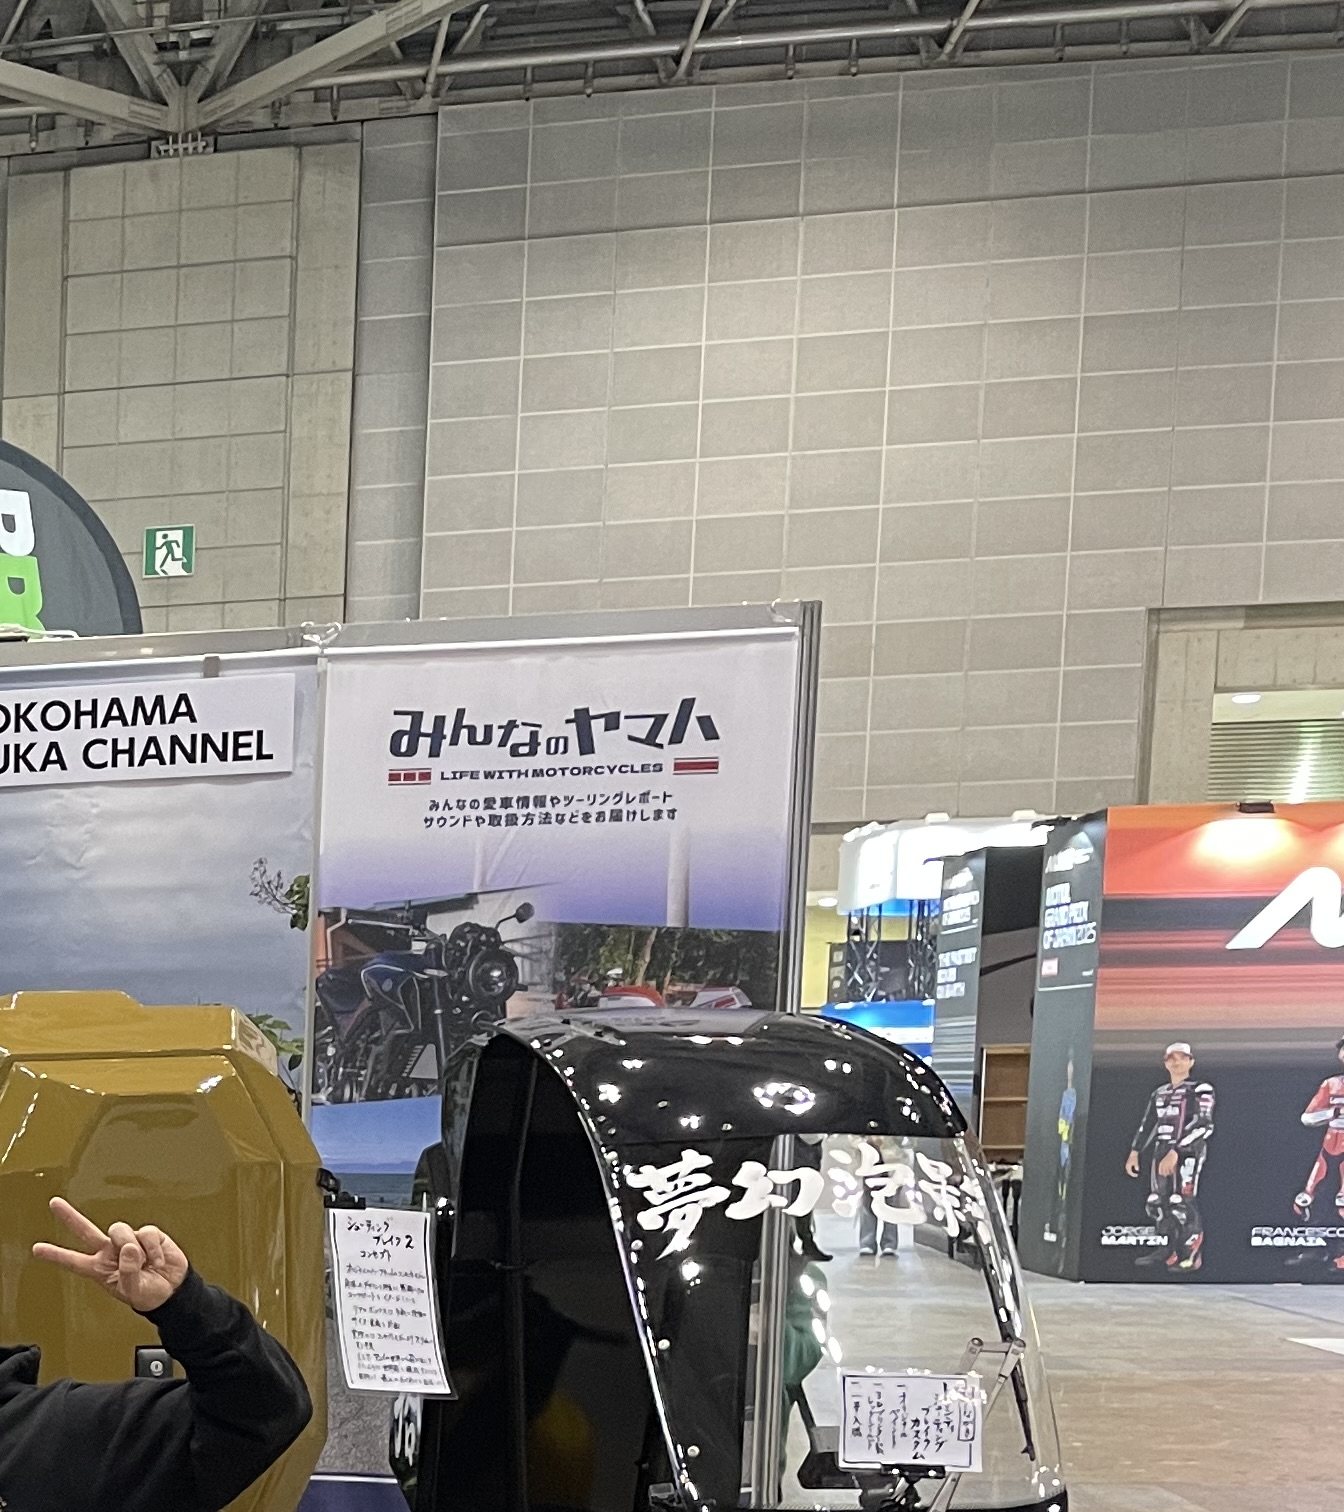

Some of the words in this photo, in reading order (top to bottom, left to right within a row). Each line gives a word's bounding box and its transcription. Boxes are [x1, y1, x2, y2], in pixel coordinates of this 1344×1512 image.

[389, 697, 720, 758] みんなのヤマハ
[91, 729, 275, 770] CHANNEL
[440, 769, 480, 781] LIFE
[483, 769, 529, 780] WITH
[531, 763, 664, 779] MOTORCYCLES
[1101, 1226, 1156, 1236] JORGE
